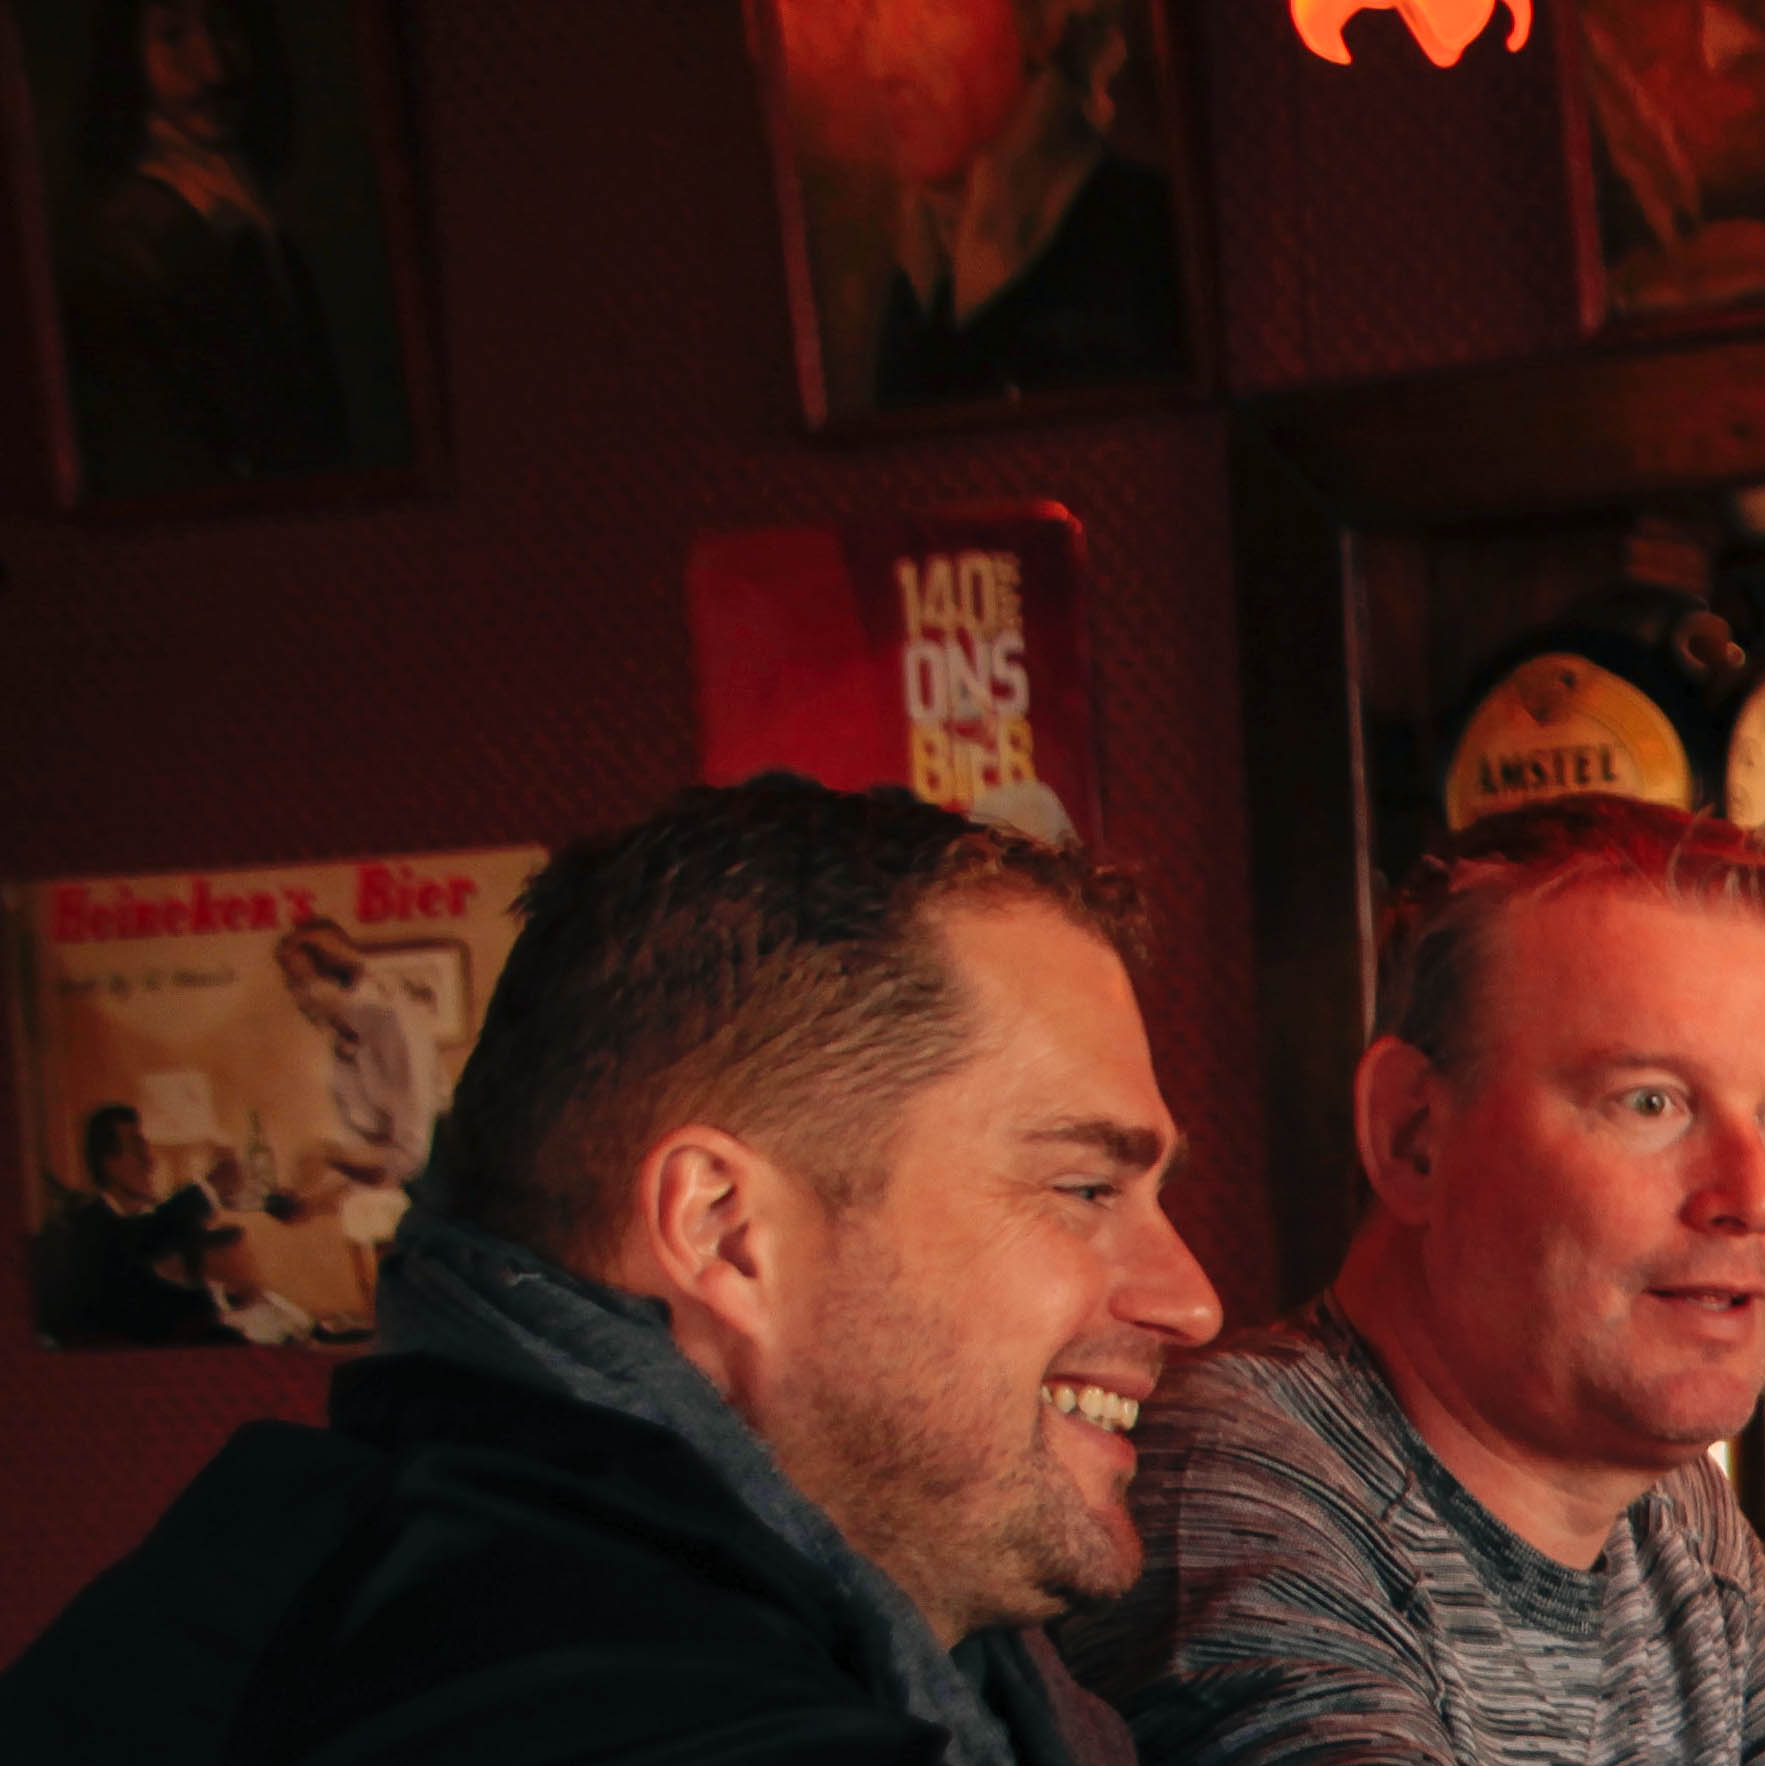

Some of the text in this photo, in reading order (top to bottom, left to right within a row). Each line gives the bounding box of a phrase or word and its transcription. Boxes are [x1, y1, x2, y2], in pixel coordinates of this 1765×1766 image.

[896, 550, 995, 640] 140
[904, 630, 1030, 720] ONS
[1480, 746, 1617, 795] AMSTEL
[356, 860, 478, 922] Bier
